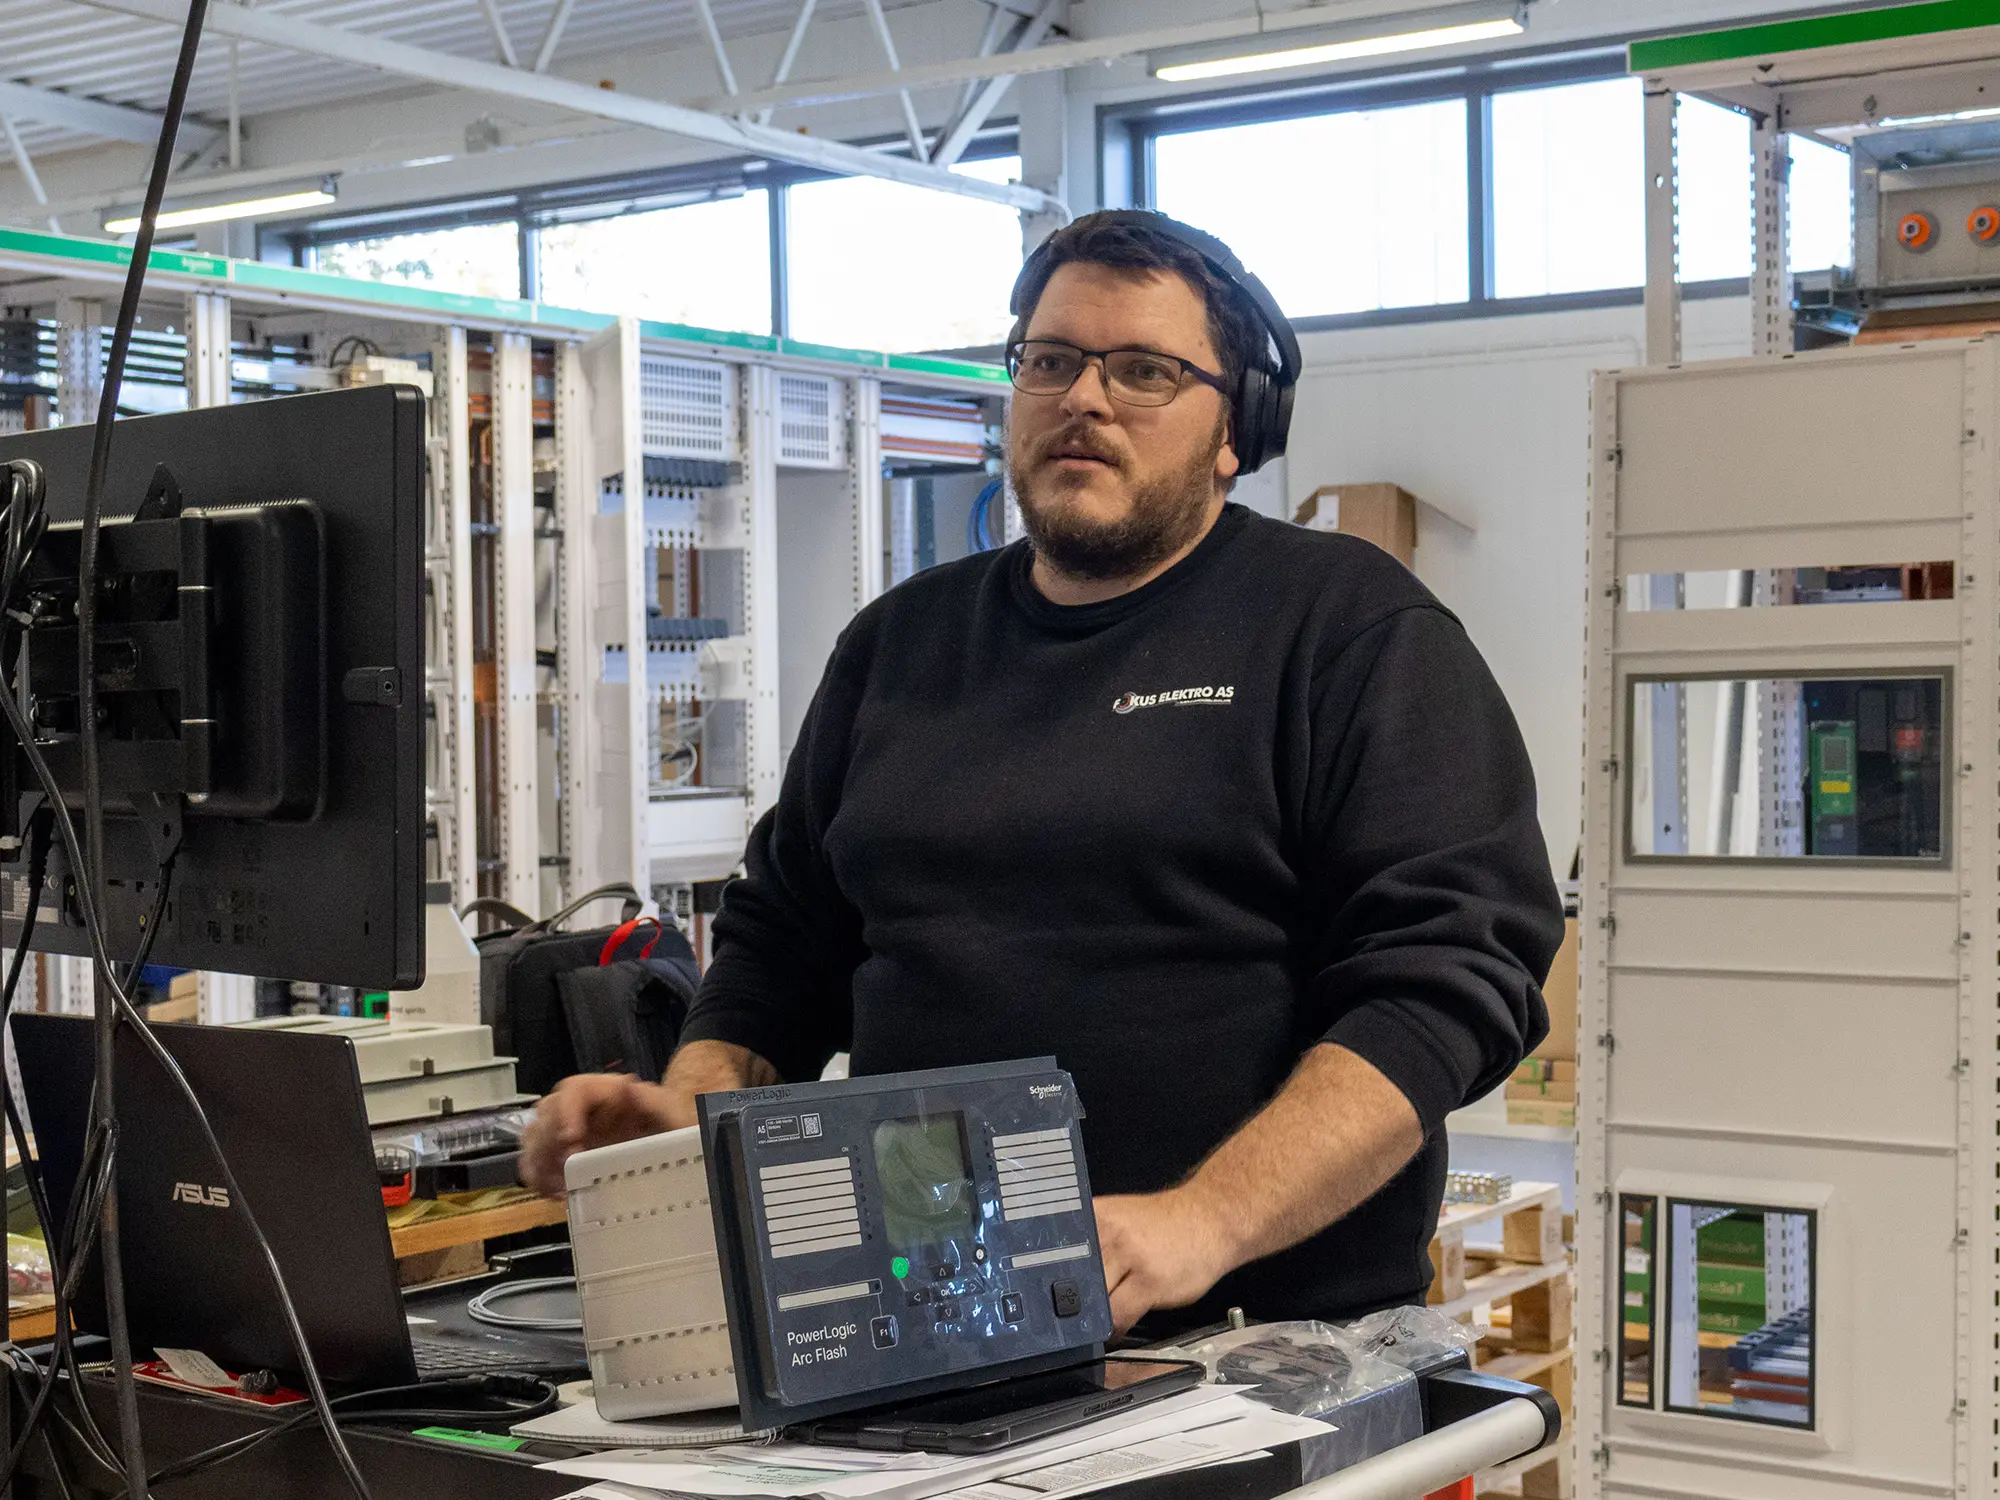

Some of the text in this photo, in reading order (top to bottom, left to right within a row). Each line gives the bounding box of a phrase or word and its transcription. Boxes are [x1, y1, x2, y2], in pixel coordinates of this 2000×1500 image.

[1158, 686, 1214, 703] ELEKTRO
[1215, 686, 1235, 698] AS
[728, 1086, 792, 1103] PowerLogic
[1029, 1084, 1062, 1095] Schneider
[757, 1125, 766, 1134] A5
[173, 1182, 230, 1208] ASUS
[940, 1288, 951, 1297] OK
[787, 1321, 858, 1347] PowerLogic
[879, 1328, 889, 1337] F1
[791, 1343, 848, 1368] Arc Flash
